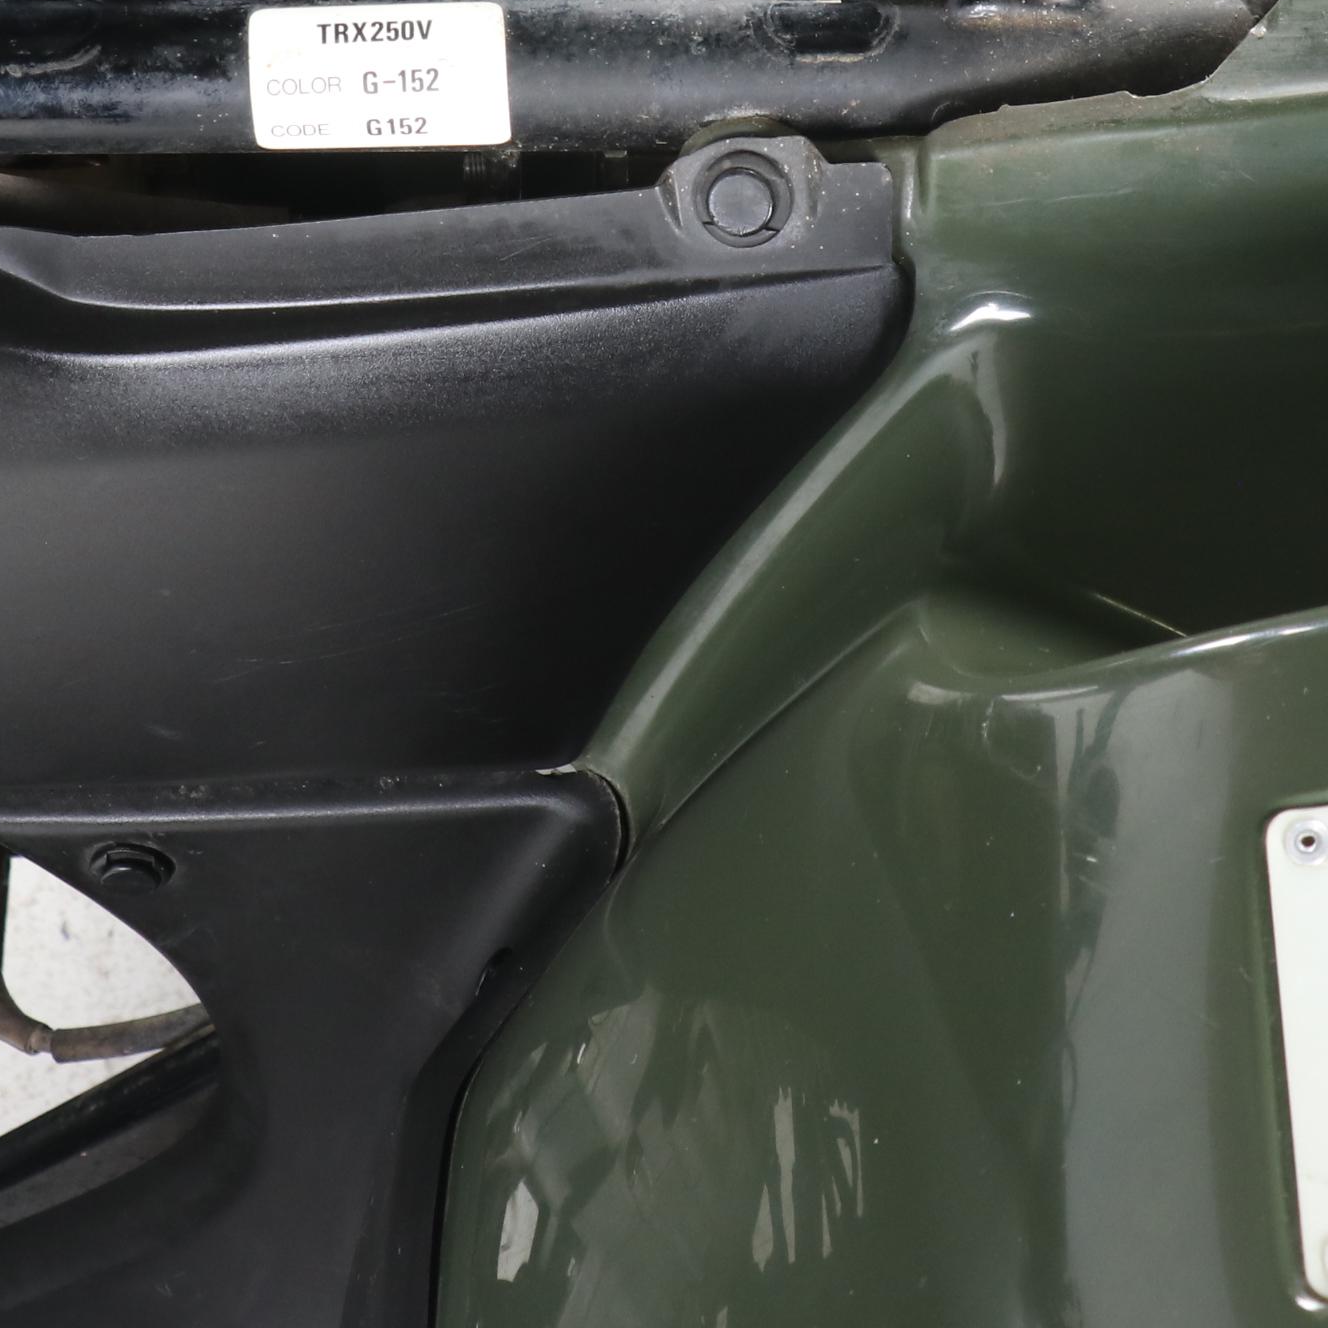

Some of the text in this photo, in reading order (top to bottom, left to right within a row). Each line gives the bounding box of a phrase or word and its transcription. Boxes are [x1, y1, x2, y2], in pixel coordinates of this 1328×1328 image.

[316, 19, 433, 45] TRX250V
[265, 67, 440, 97] COLOR G-152
[270, 116, 429, 138] CODE G152
